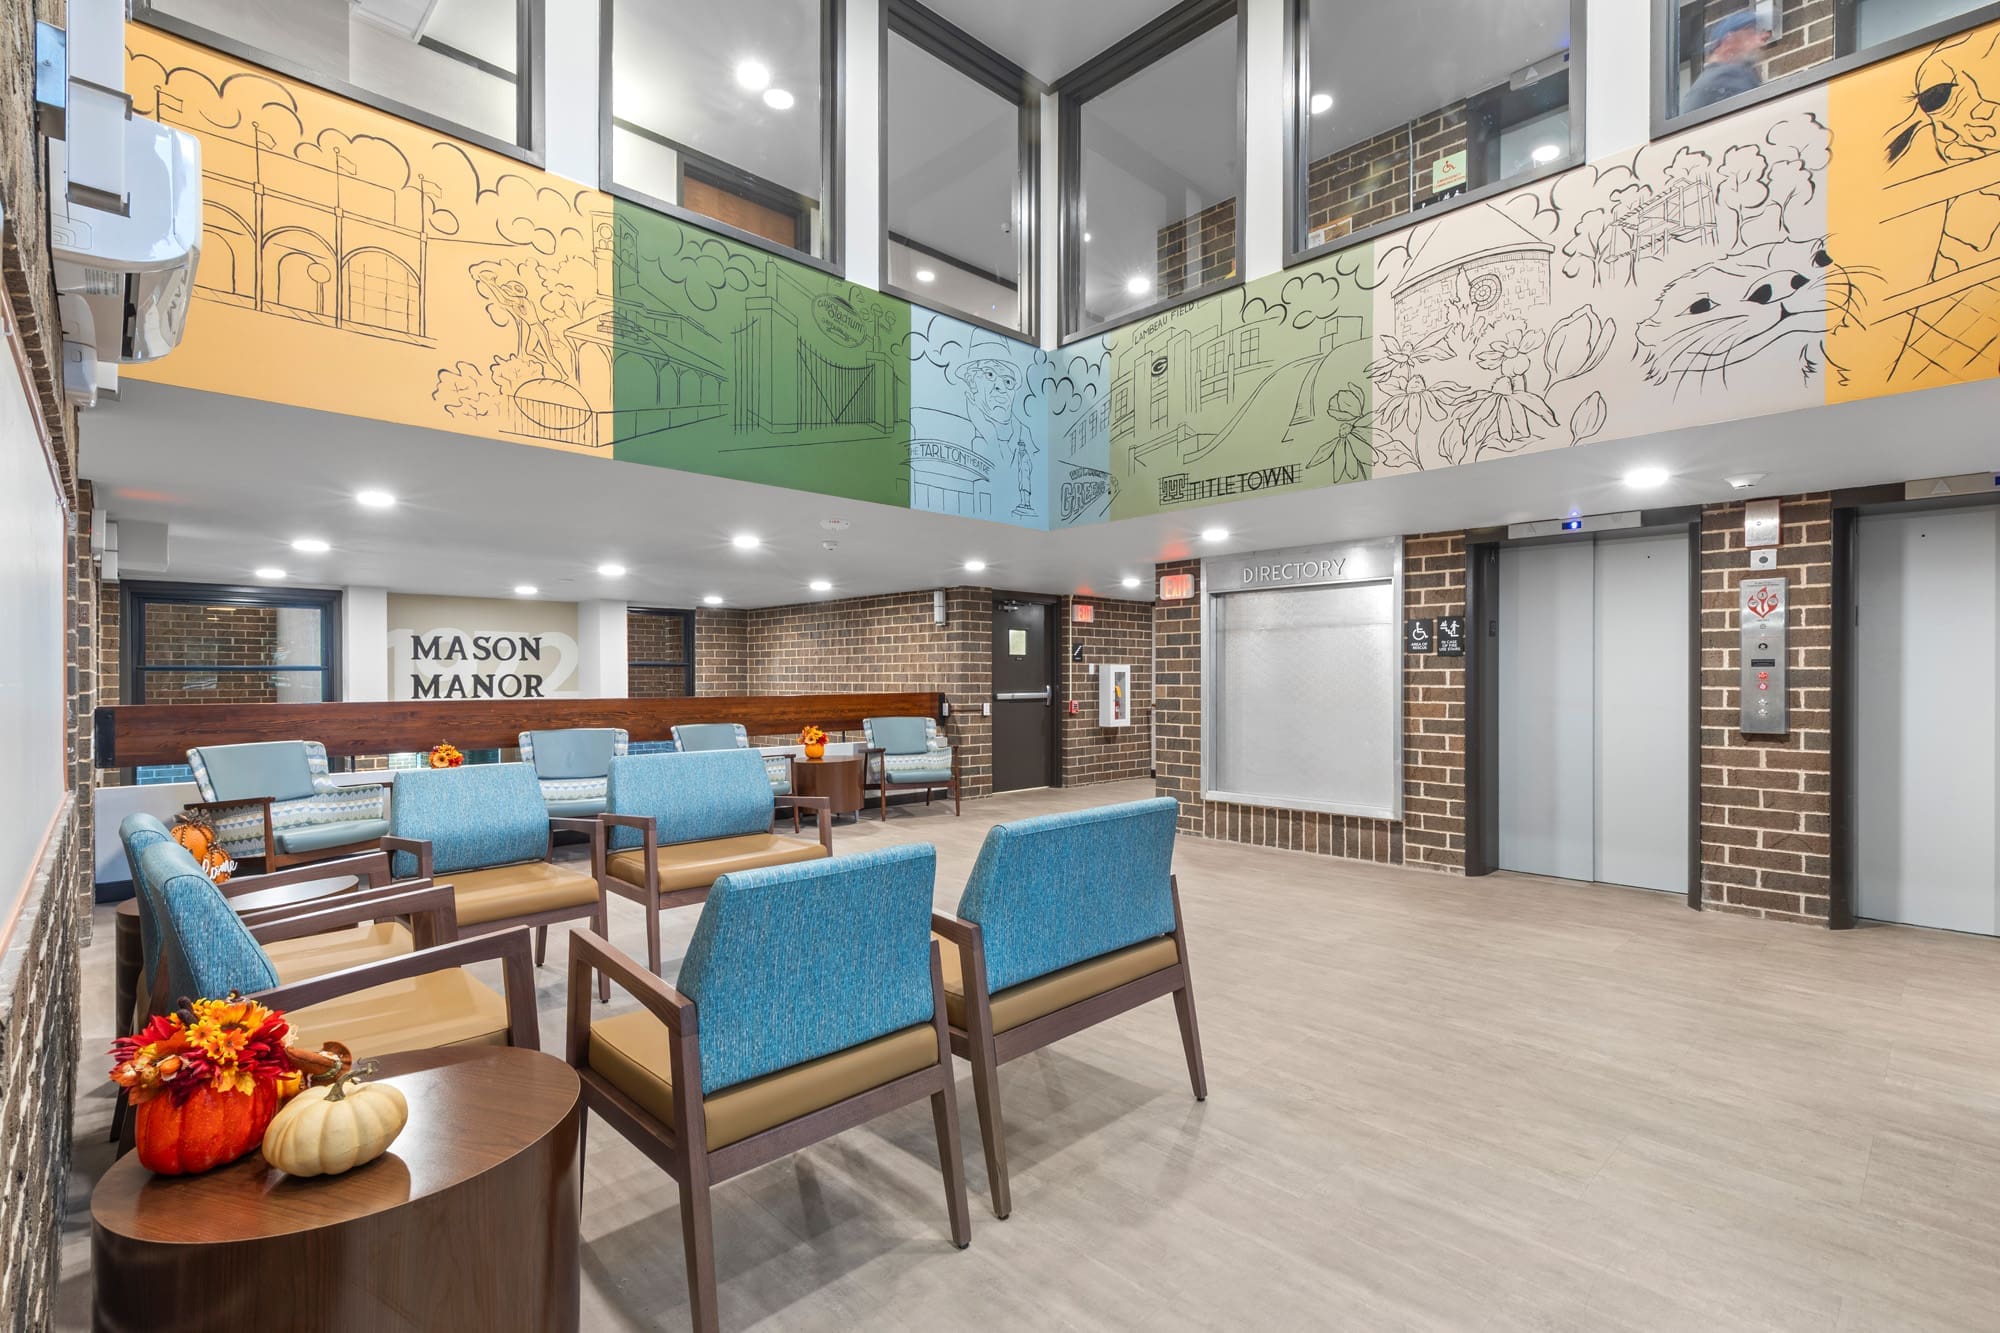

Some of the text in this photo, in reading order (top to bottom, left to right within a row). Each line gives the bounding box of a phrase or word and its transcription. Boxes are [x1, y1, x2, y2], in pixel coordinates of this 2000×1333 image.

[1134, 302, 1195, 346] LAMBEAU FIELD
[919, 443, 967, 465] TARLTON
[1189, 464, 1294, 500] TITLETOWN
[1243, 558, 1347, 584] DIRECTORY
[411, 635, 542, 661] MASON
[411, 673, 544, 699] MANOR
